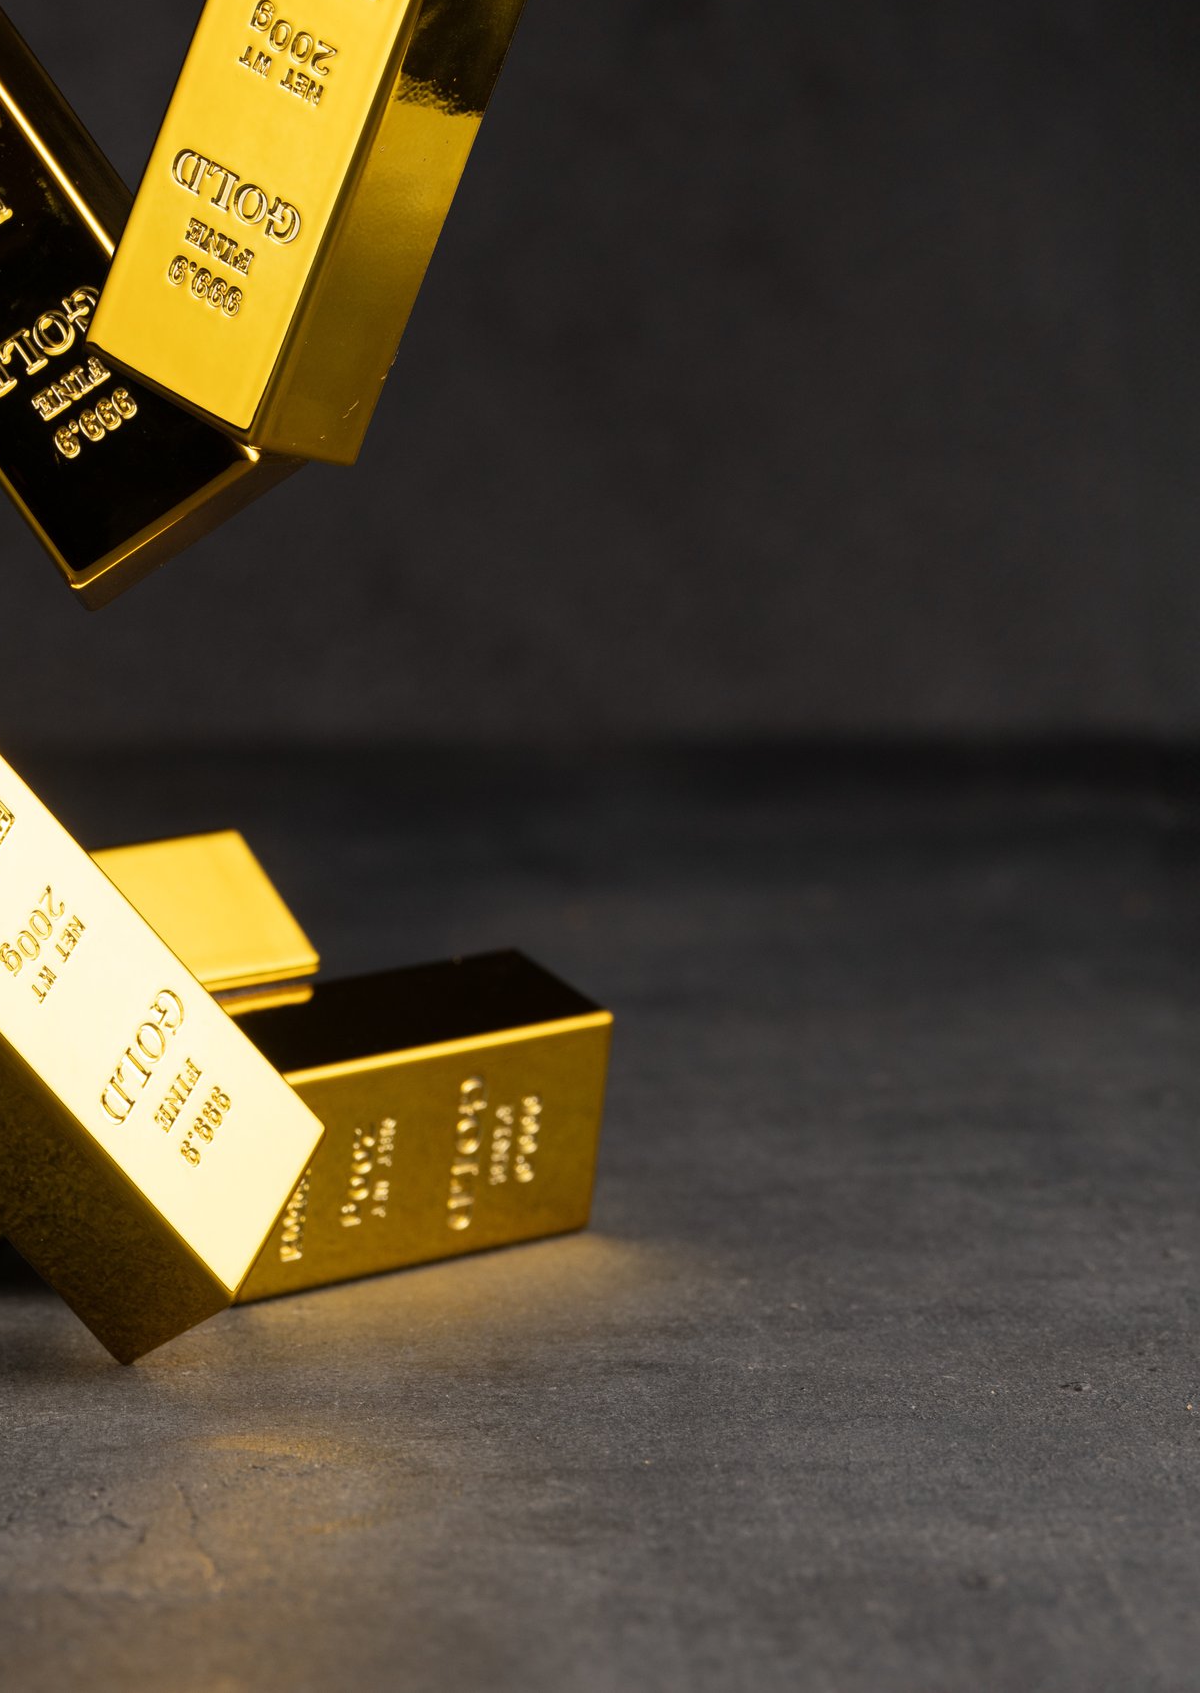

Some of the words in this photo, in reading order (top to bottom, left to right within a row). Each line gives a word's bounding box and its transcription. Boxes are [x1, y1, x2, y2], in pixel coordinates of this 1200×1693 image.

[239, 45, 270, 77] WT
[280, 67, 323, 106] NET
[171, 148, 301, 244] GOLD
[185, 217, 255, 275] FINE
[167, 254, 242, 317] 999.9
[31, 356, 111, 421] FINE
[54, 387, 138, 458] 999.9
[55, 915, 86, 963] NET
[32, 965, 57, 1003] WT
[100, 989, 185, 1125] GOLD
[154, 1058, 202, 1133] FINE
[180, 1086, 231, 1167] 999.9
